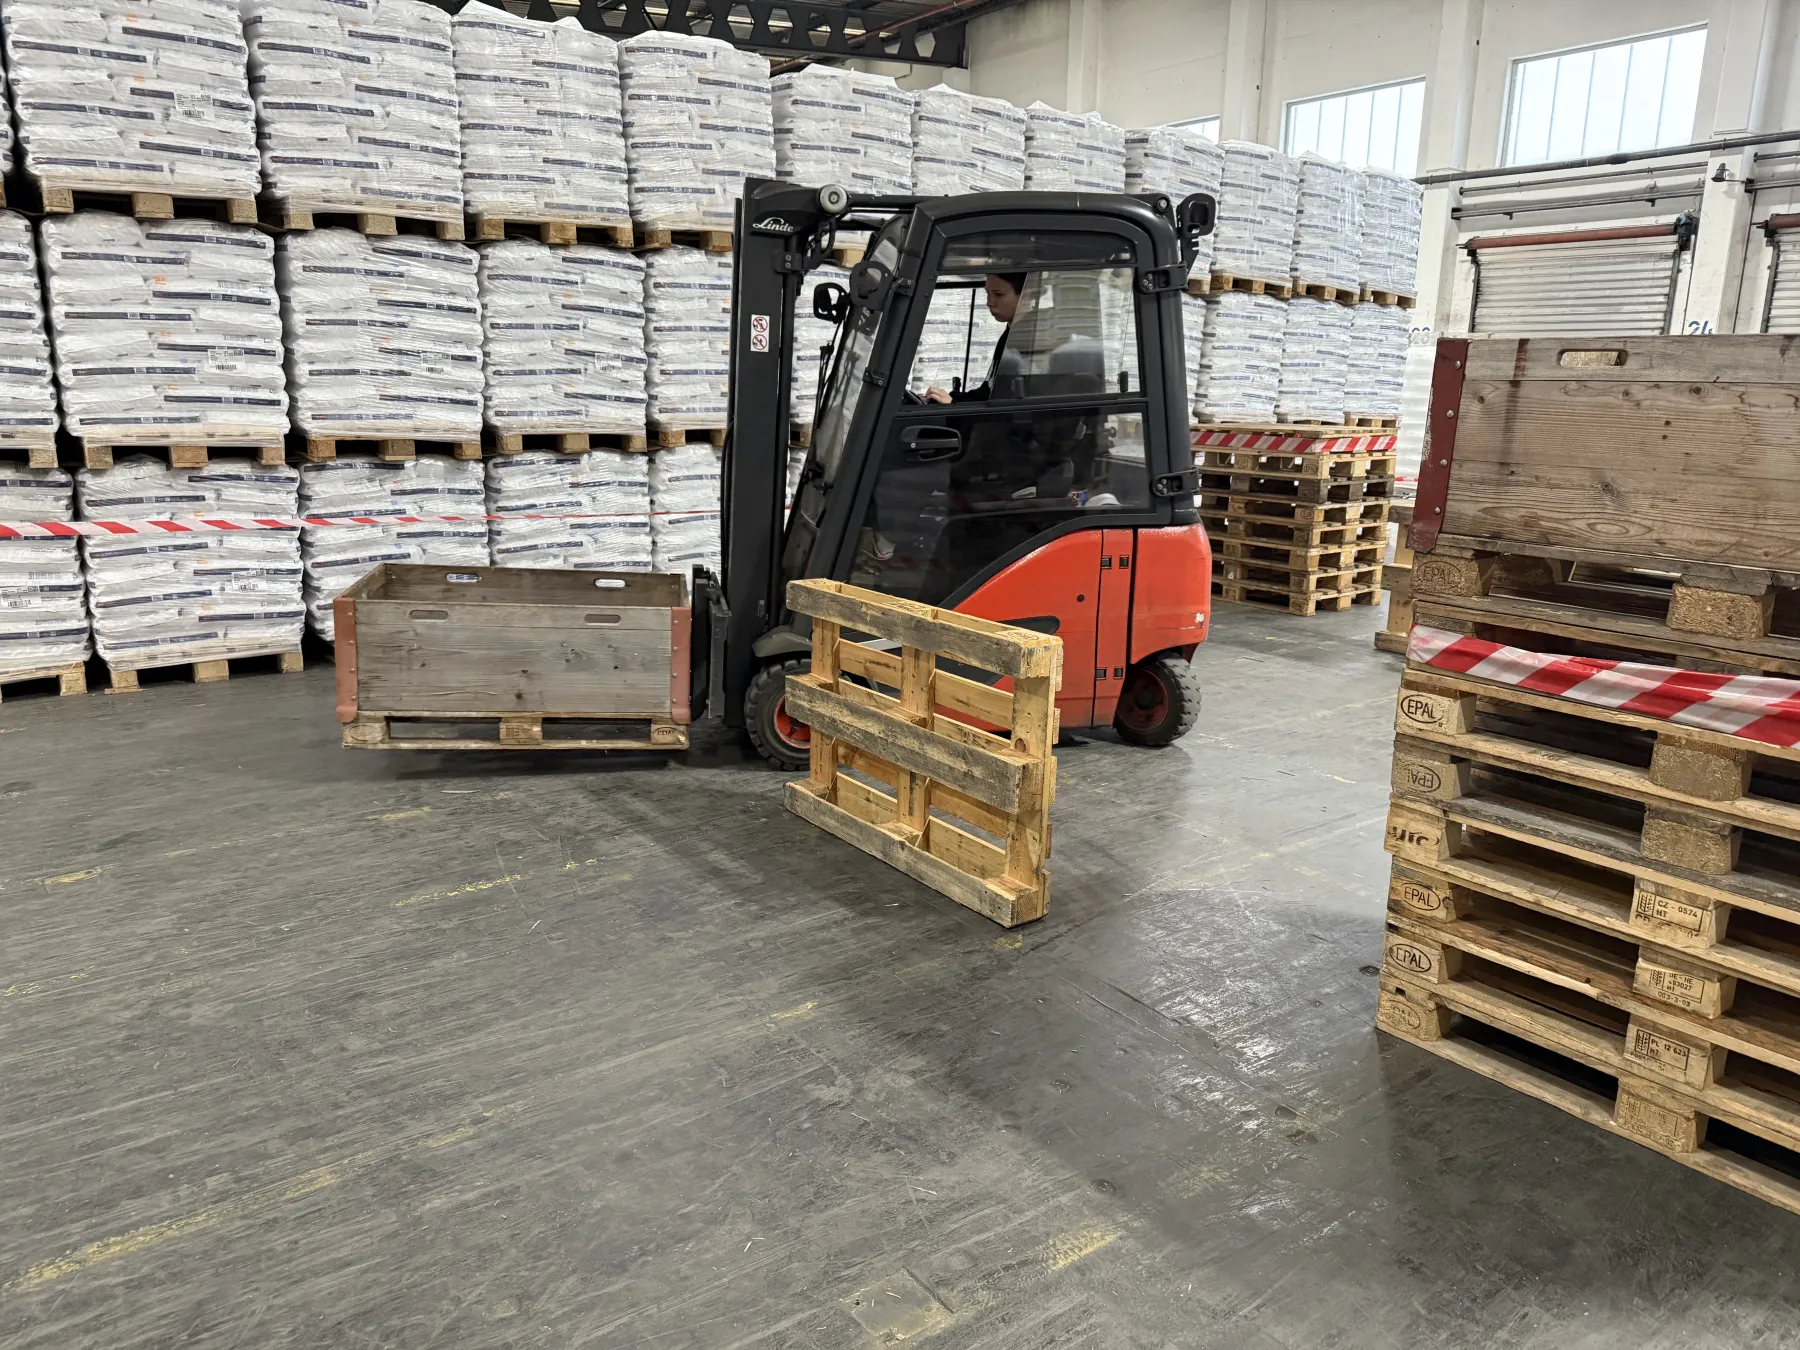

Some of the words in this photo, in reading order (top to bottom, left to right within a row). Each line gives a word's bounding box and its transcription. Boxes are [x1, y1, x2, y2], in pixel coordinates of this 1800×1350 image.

[752, 217, 794, 233] Linde
[1407, 698, 1436, 719] EPAL
[1404, 886, 1434, 908] EPAL
[1656, 908, 1669, 918] HT
[1657, 899, 1669, 909] CZ
[1677, 906, 1698, 918] 0574
[1396, 947, 1425, 970] EPAL
[1651, 1038, 1660, 1048] PL
[1664, 1043, 1671, 1052] 12
[1673, 1047, 1687, 1057] 623
